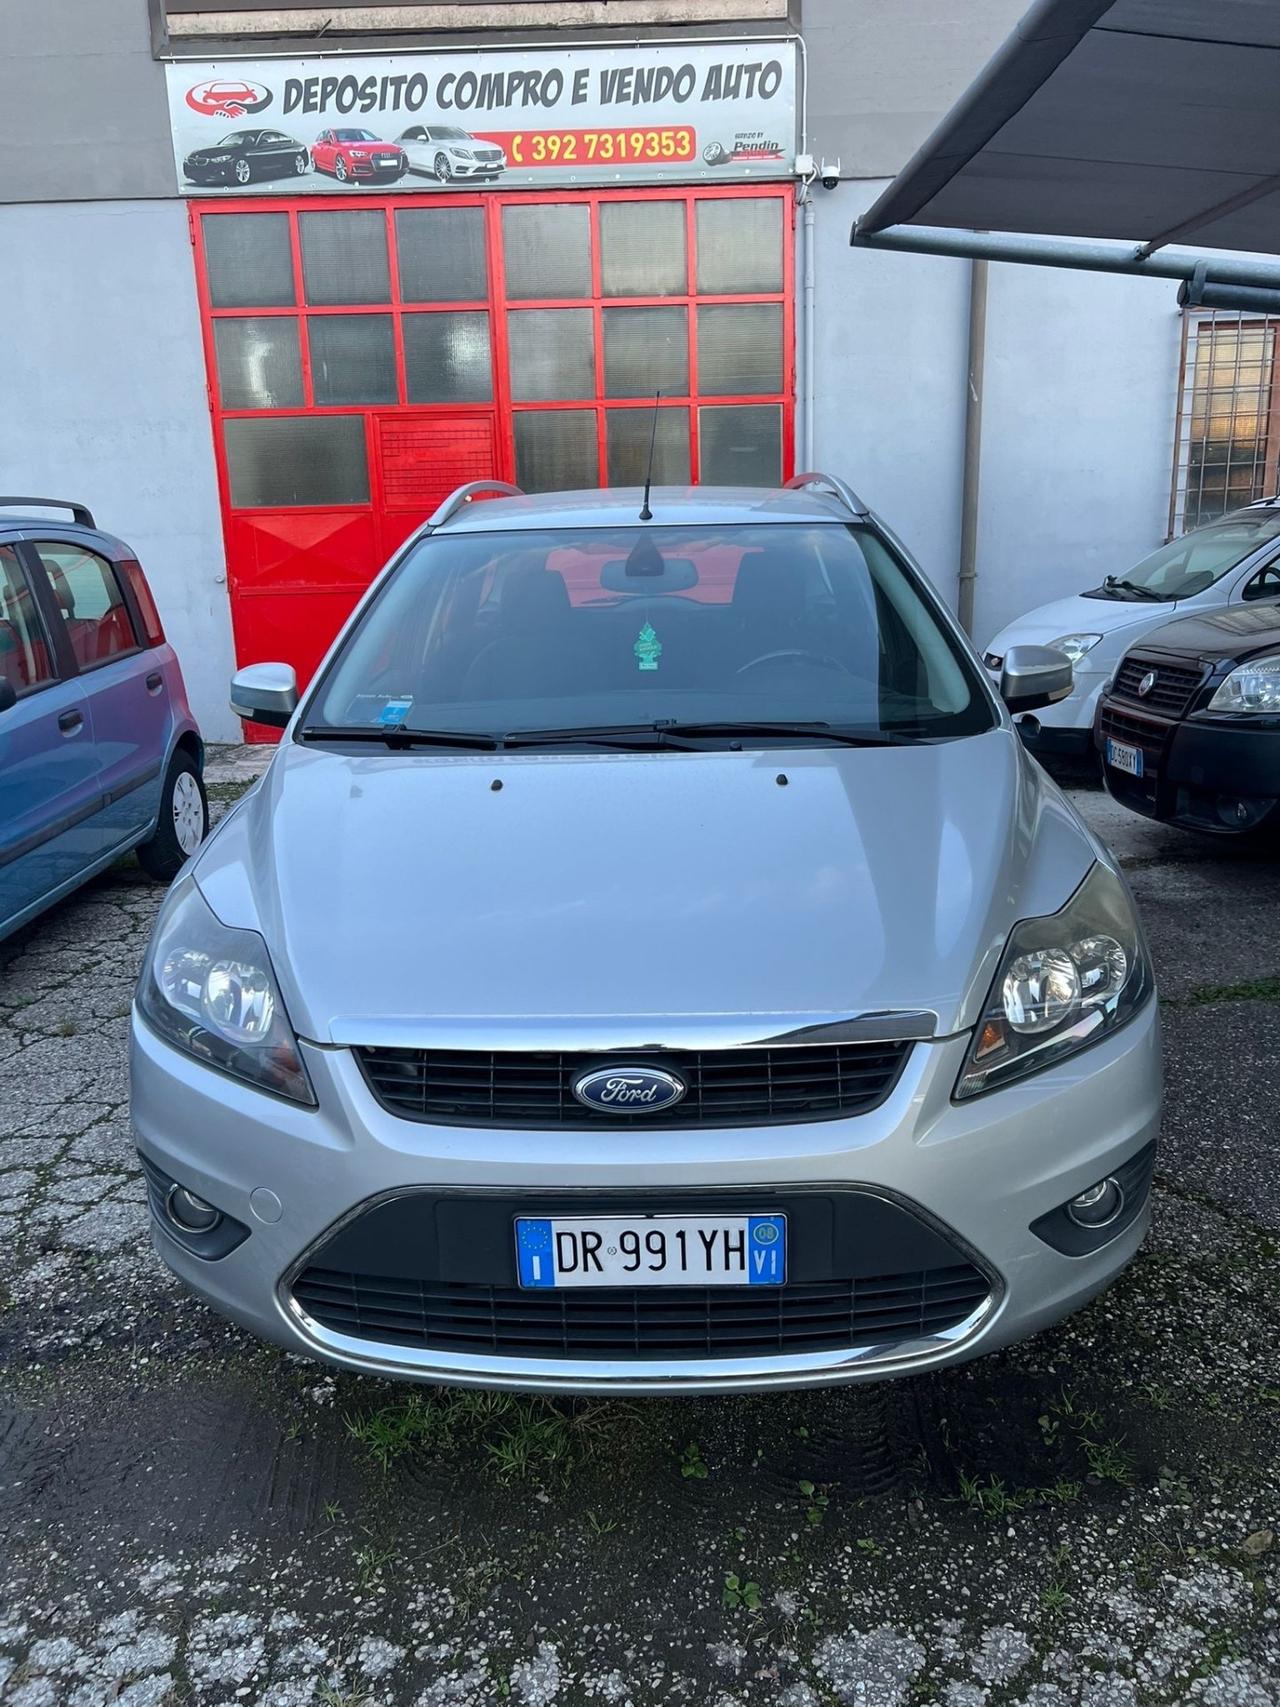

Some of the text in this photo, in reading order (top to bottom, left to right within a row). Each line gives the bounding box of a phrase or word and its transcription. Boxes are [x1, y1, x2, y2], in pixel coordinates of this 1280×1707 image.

[283, 60, 783, 115] DEPOSITO COMPRO E VENDO AUTO
[531, 131, 691, 160] 392 7319353
[734, 140, 779, 151] Pendin
[601, 1078, 658, 1102] Ford
[753, 1250, 777, 1275] VI
